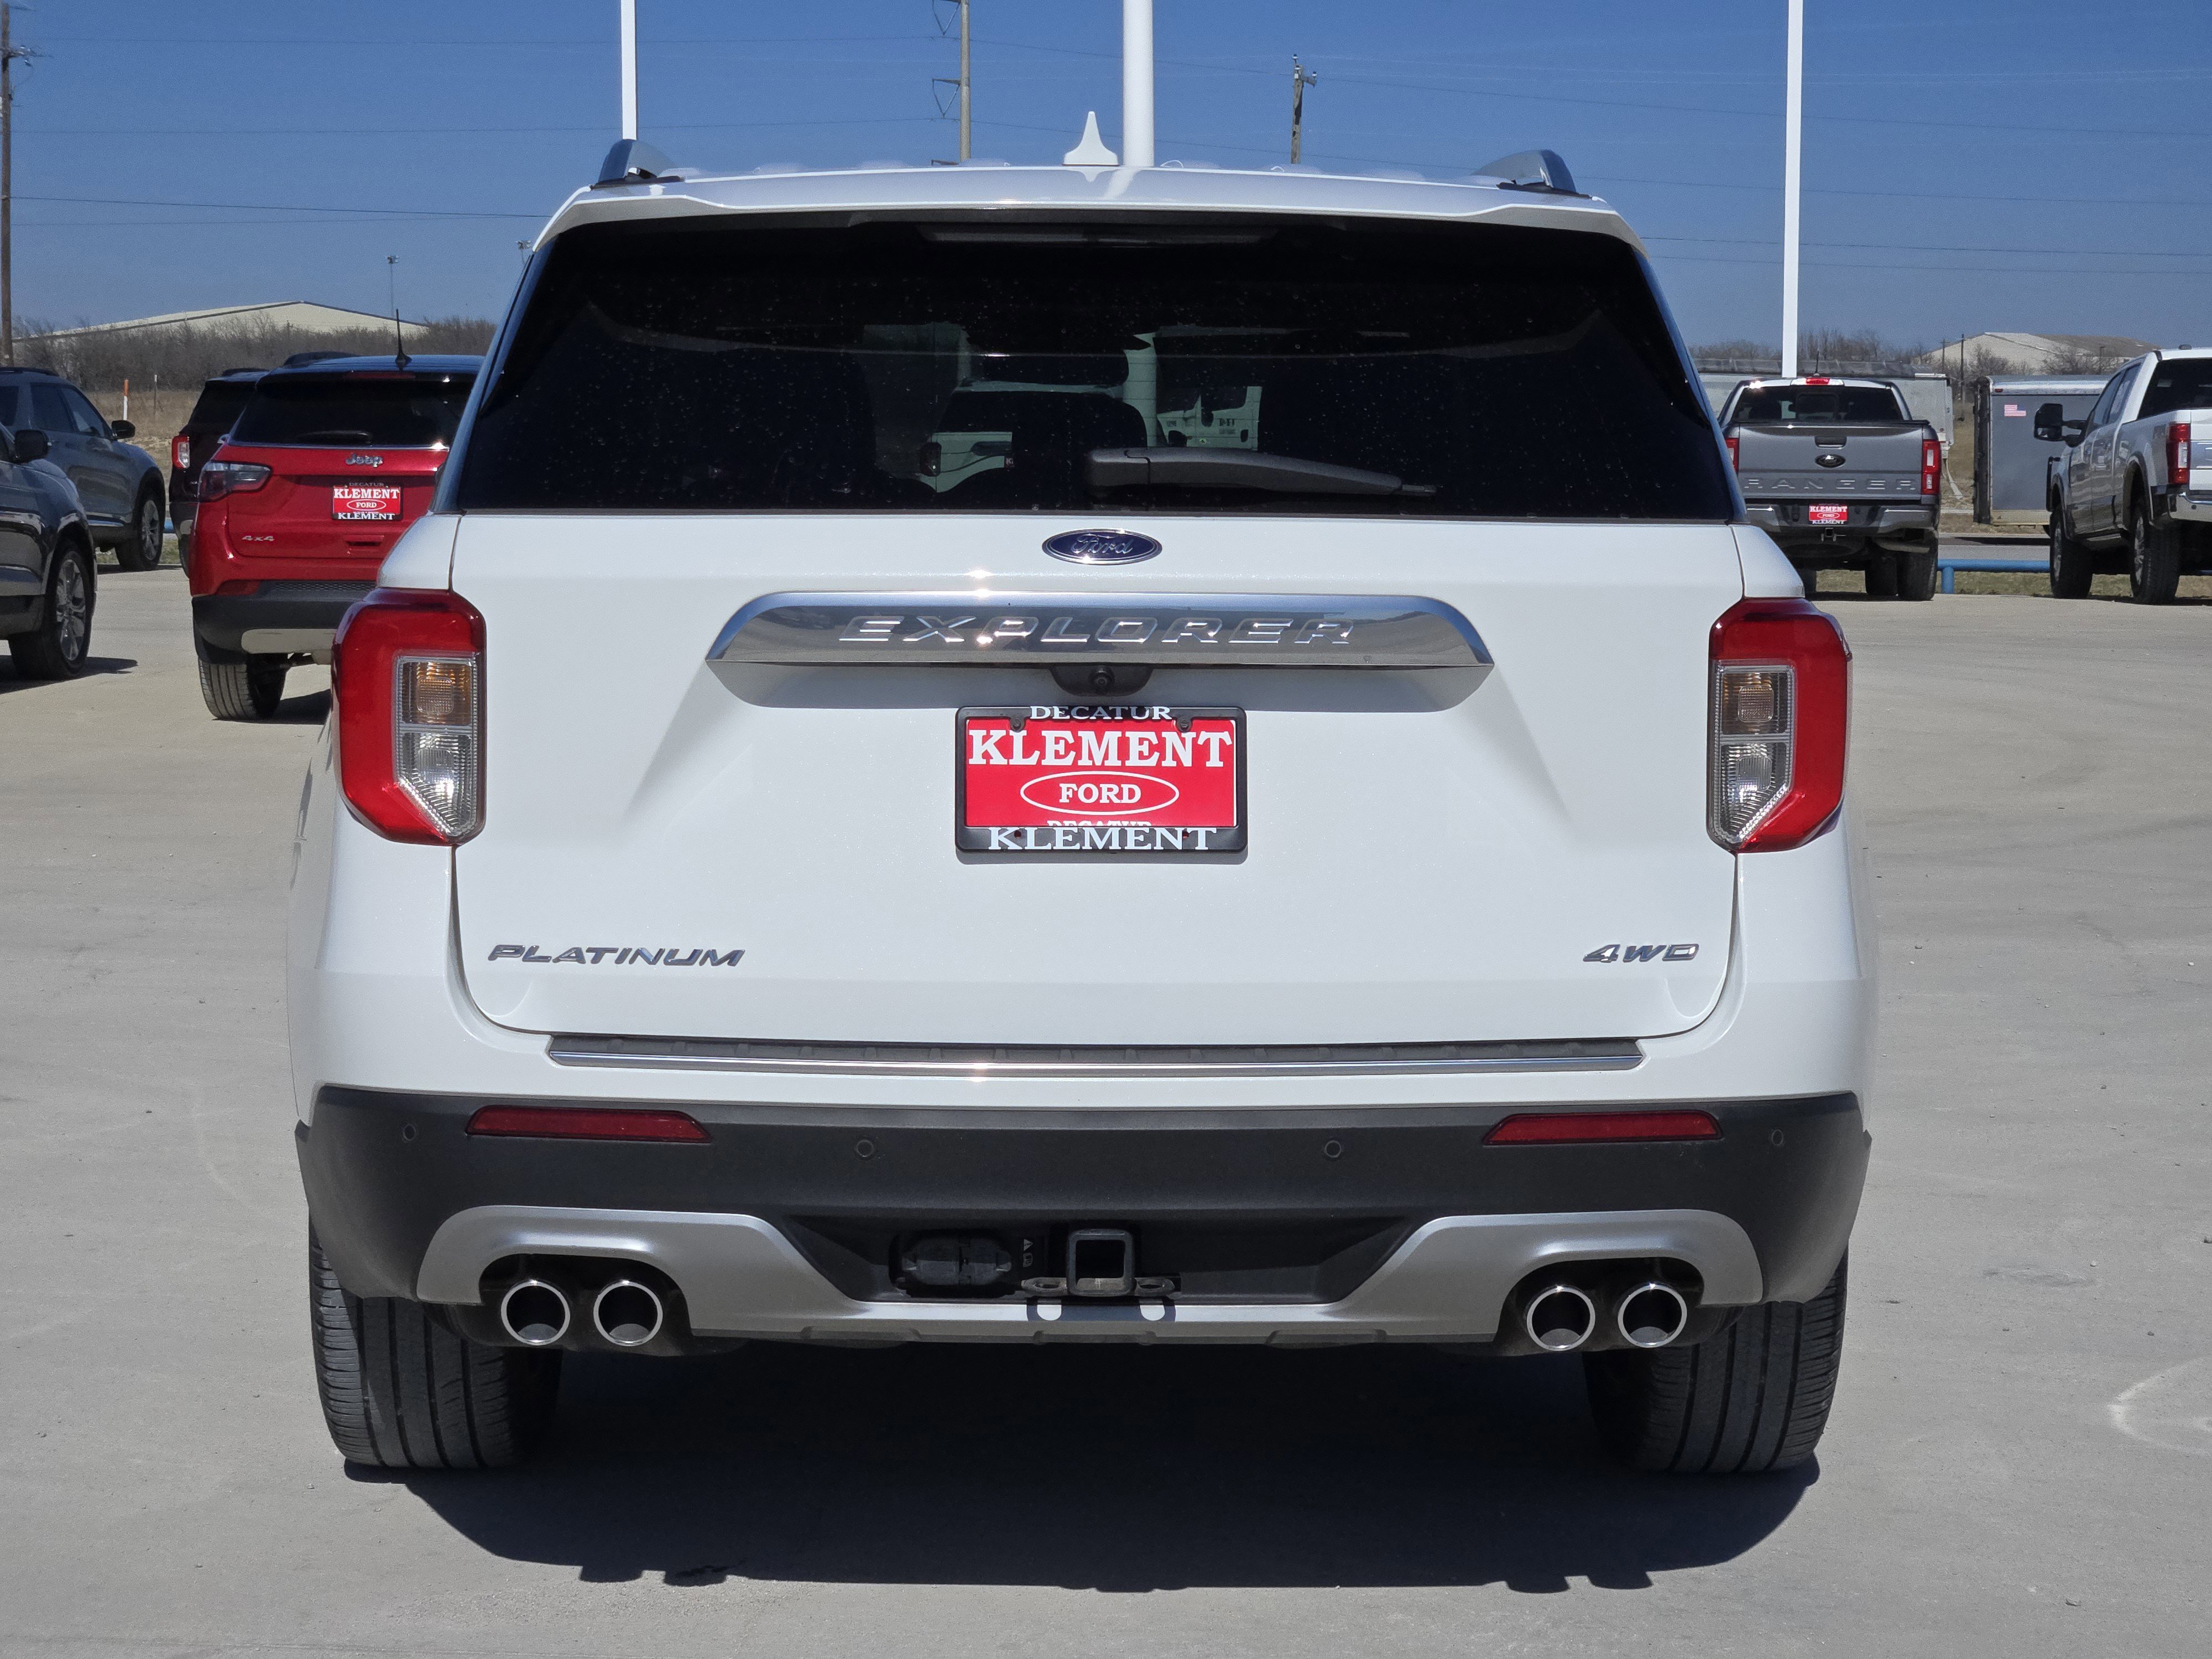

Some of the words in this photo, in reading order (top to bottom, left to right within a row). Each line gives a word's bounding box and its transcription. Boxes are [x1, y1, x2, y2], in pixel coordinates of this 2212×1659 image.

[346, 453, 383, 467] Jeep
[333, 488, 400, 499] KLEMENT
[1071, 534, 1133, 554] Ford
[838, 615, 1354, 645] EXPLORER
[1030, 706, 1172, 720] DECATUR
[968, 729, 1233, 768] KLEMENT
[1059, 783, 1141, 804] FORD
[988, 827, 1217, 851] KLEMENT
[488, 944, 745, 967] PLATINUM
[1583, 943, 1699, 963] 4WD
